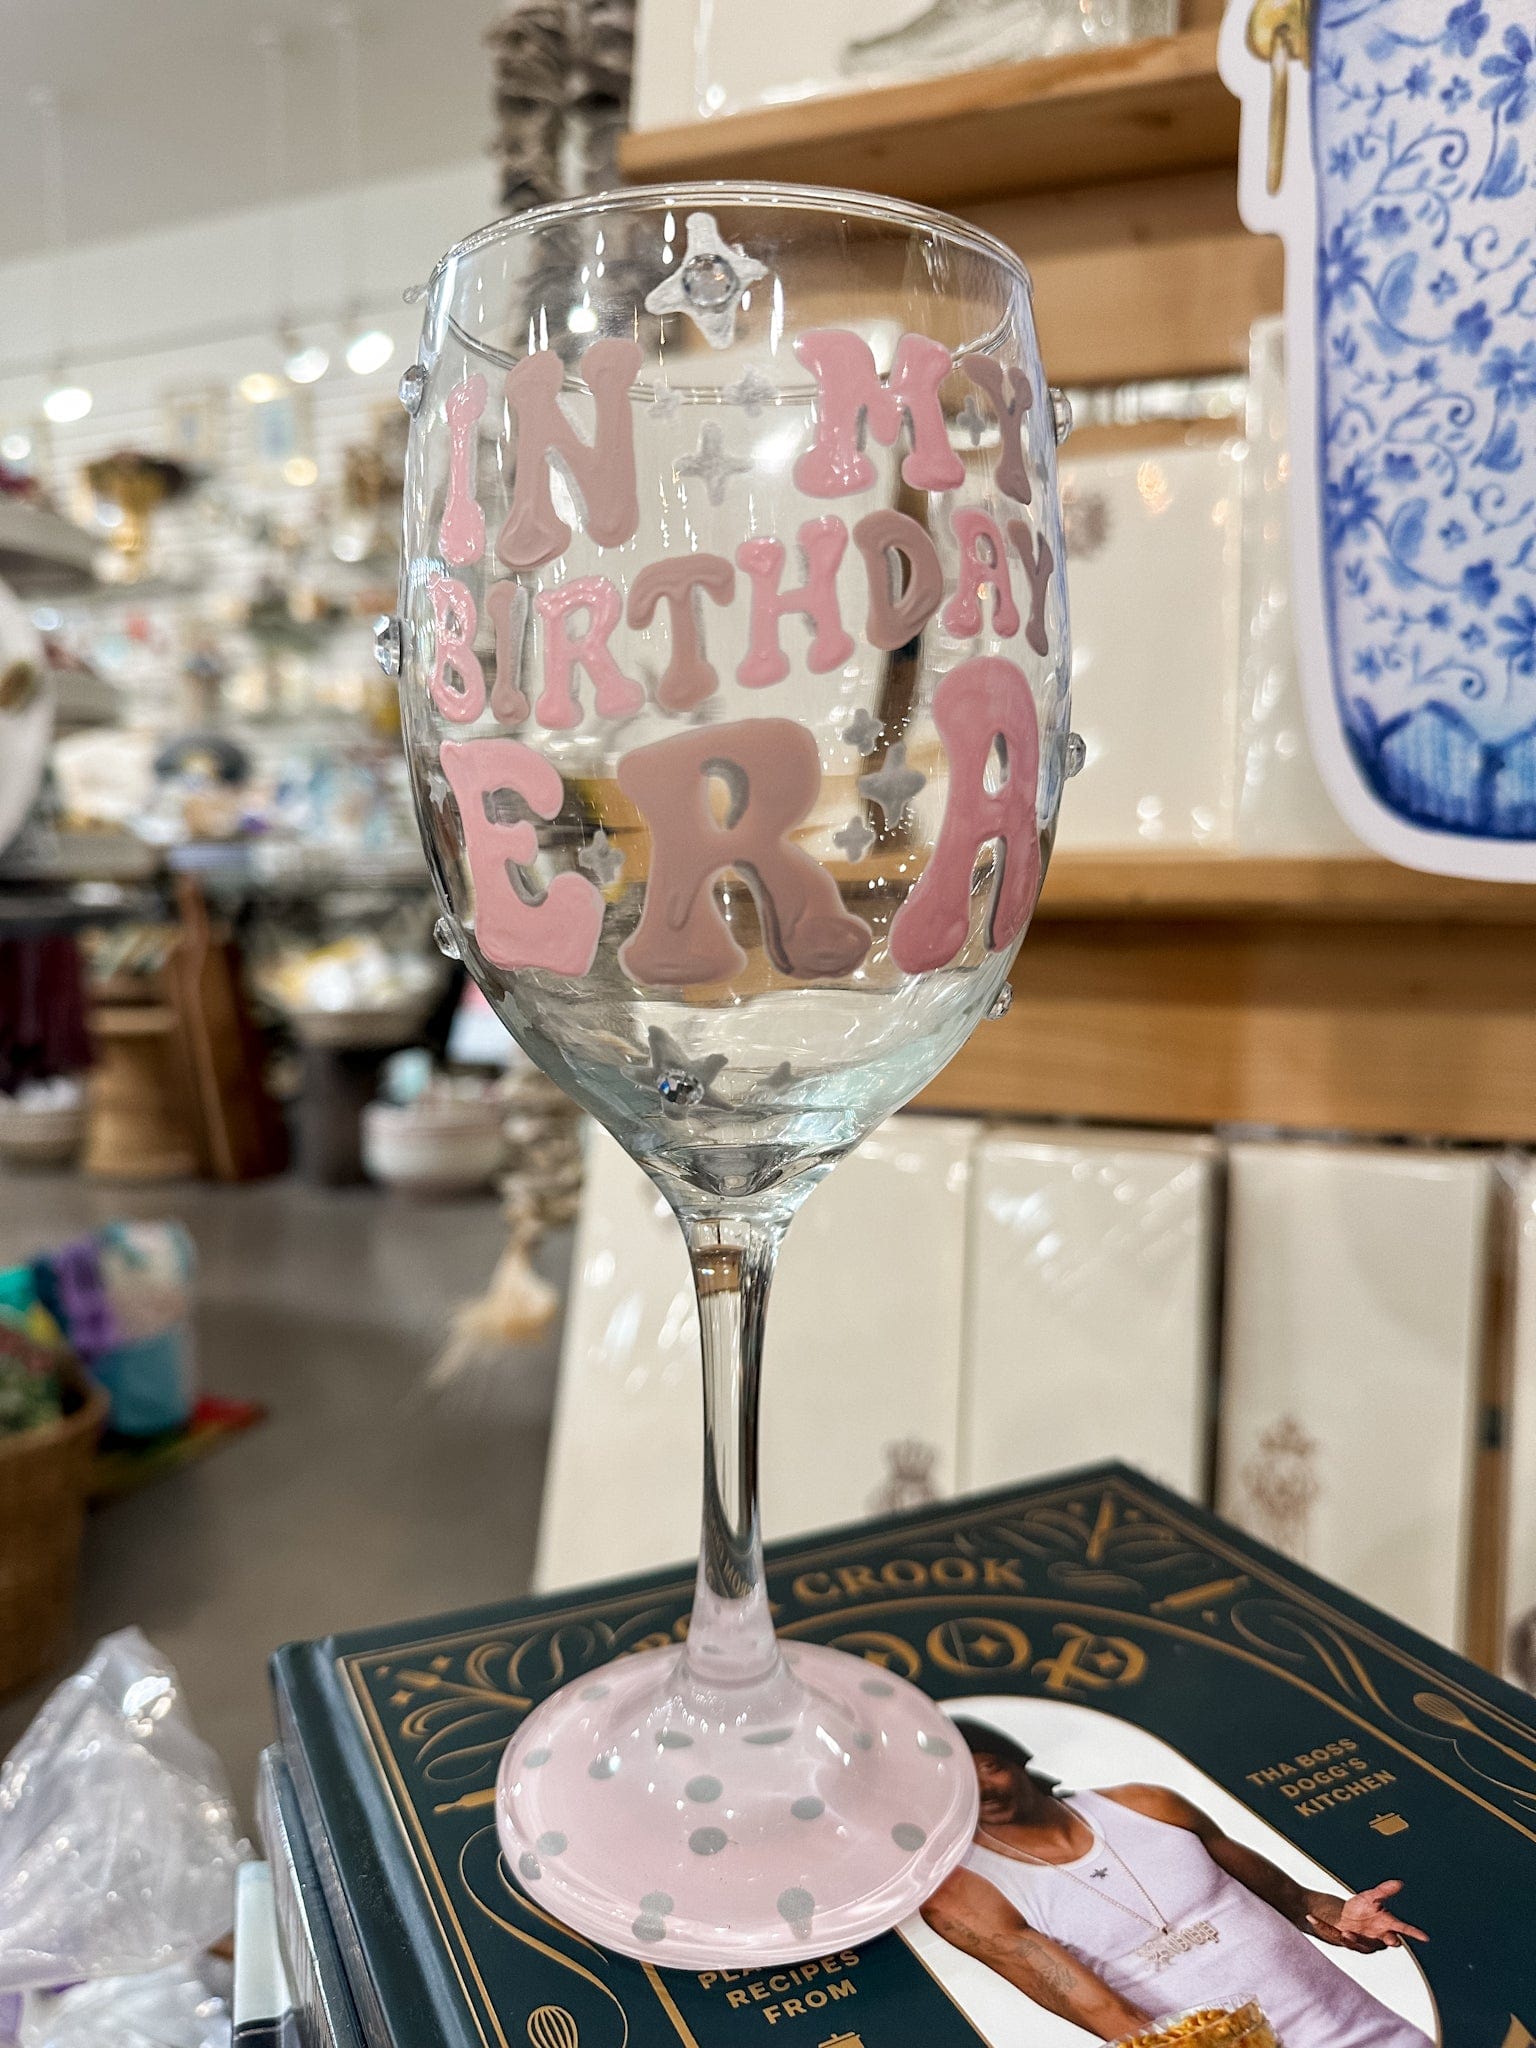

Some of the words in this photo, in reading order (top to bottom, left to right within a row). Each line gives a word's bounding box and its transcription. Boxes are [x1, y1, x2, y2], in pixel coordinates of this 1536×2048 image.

[440, 336, 643, 569] IN
[793, 329, 1034, 505] MY
[428, 507, 1053, 729] BIRTHDAY
[439, 656, 1041, 985] ERA
[793, 1558, 1027, 1599] CROOK
[1245, 1762, 1298, 1786] THA
[1294, 1738, 1358, 1768] BOSS
[1279, 1757, 1368, 1798] DOGG'S
[1294, 1769, 1397, 1817] KITCHEN
[726, 1950, 860, 2008] RECIPES
[762, 1979, 857, 2024] FROM
